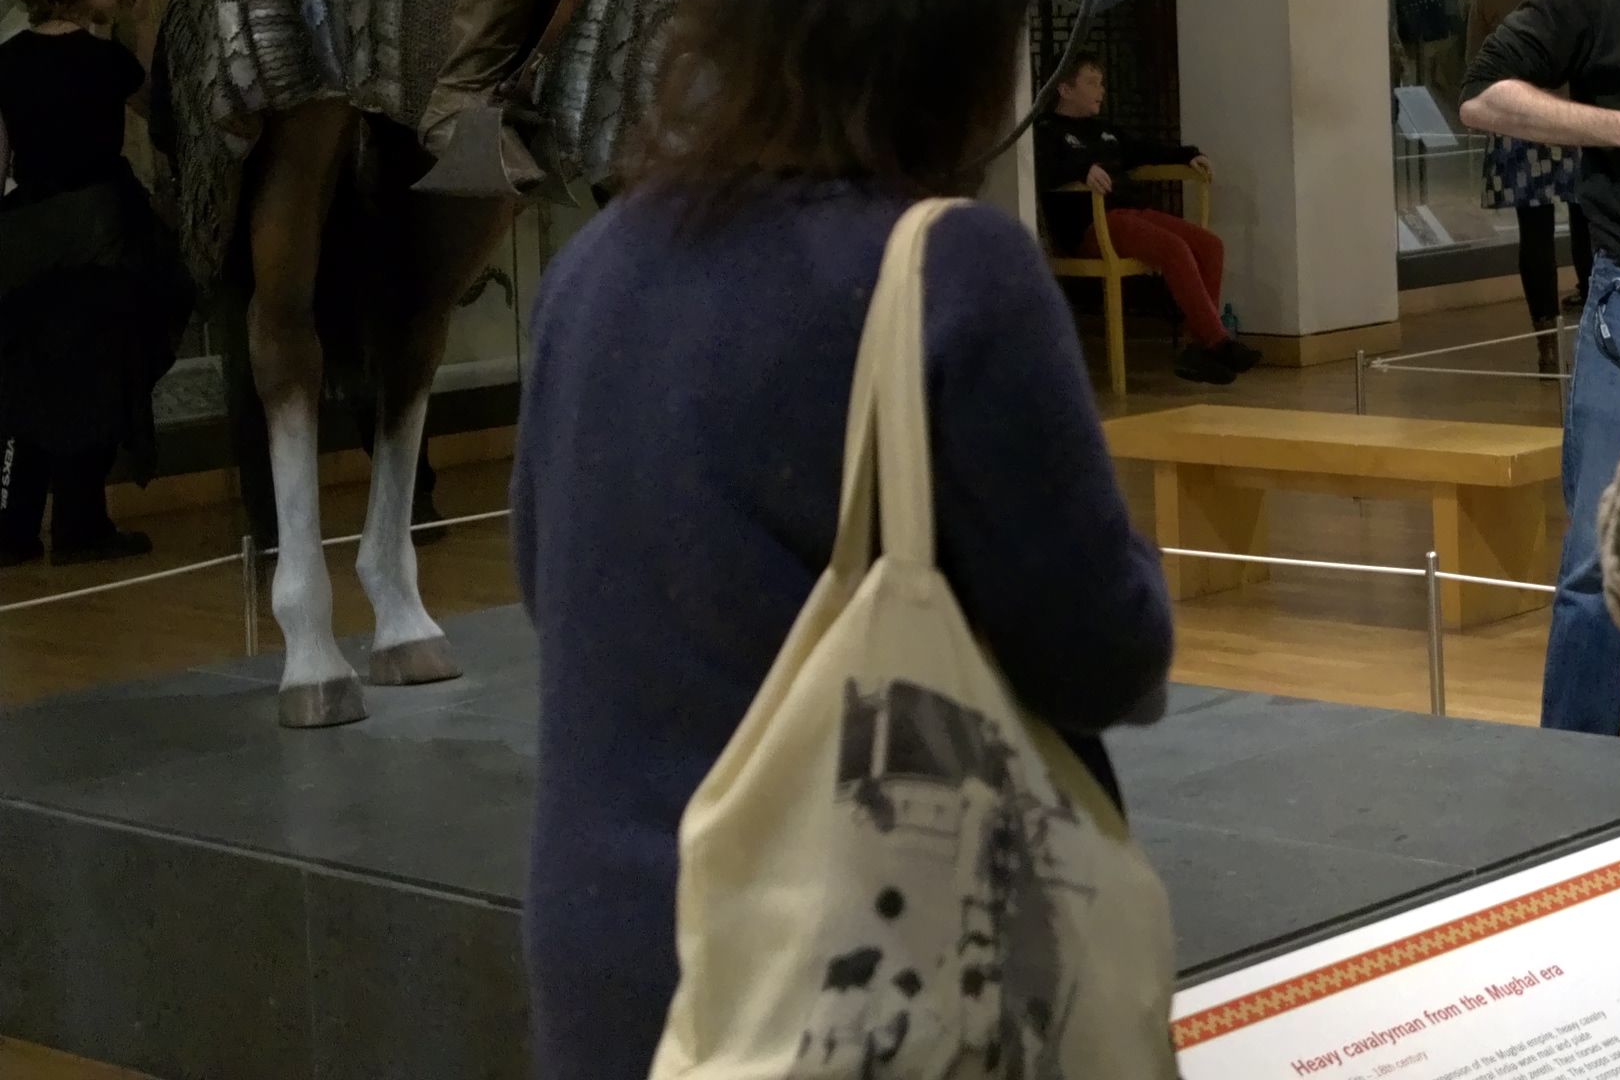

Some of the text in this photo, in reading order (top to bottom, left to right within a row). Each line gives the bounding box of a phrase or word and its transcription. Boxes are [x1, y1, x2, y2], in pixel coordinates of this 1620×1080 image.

[1291, 965, 1564, 1076] Heavy cavalryman from the Mughal era
[1472, 1059, 1482, 1070] of
[1480, 1053, 1497, 1066] the
[1495, 1042, 1527, 1060] Mughal
[1526, 1029, 1558, 1047] empire,
[1555, 1021, 1580, 1035] heavy
[1579, 1010, 1607, 1026] cavalry
[1494, 1063, 1518, 1076] India
[1517, 1055, 1538, 1067] wore
[1537, 1046, 1556, 1059] mail
[1555, 1039, 1572, 1051] and
[1571, 1032, 1592, 1047] plate
[1553, 1054, 1576, 1069] Their
[1574, 1042, 1603, 1059] horses
[1601, 1036, 1620, 1048] were
[1396, 1051, 1428, 1070] century
[1567, 1067, 1586, 1077] The
[1583, 1056, 1610, 1072] troops
